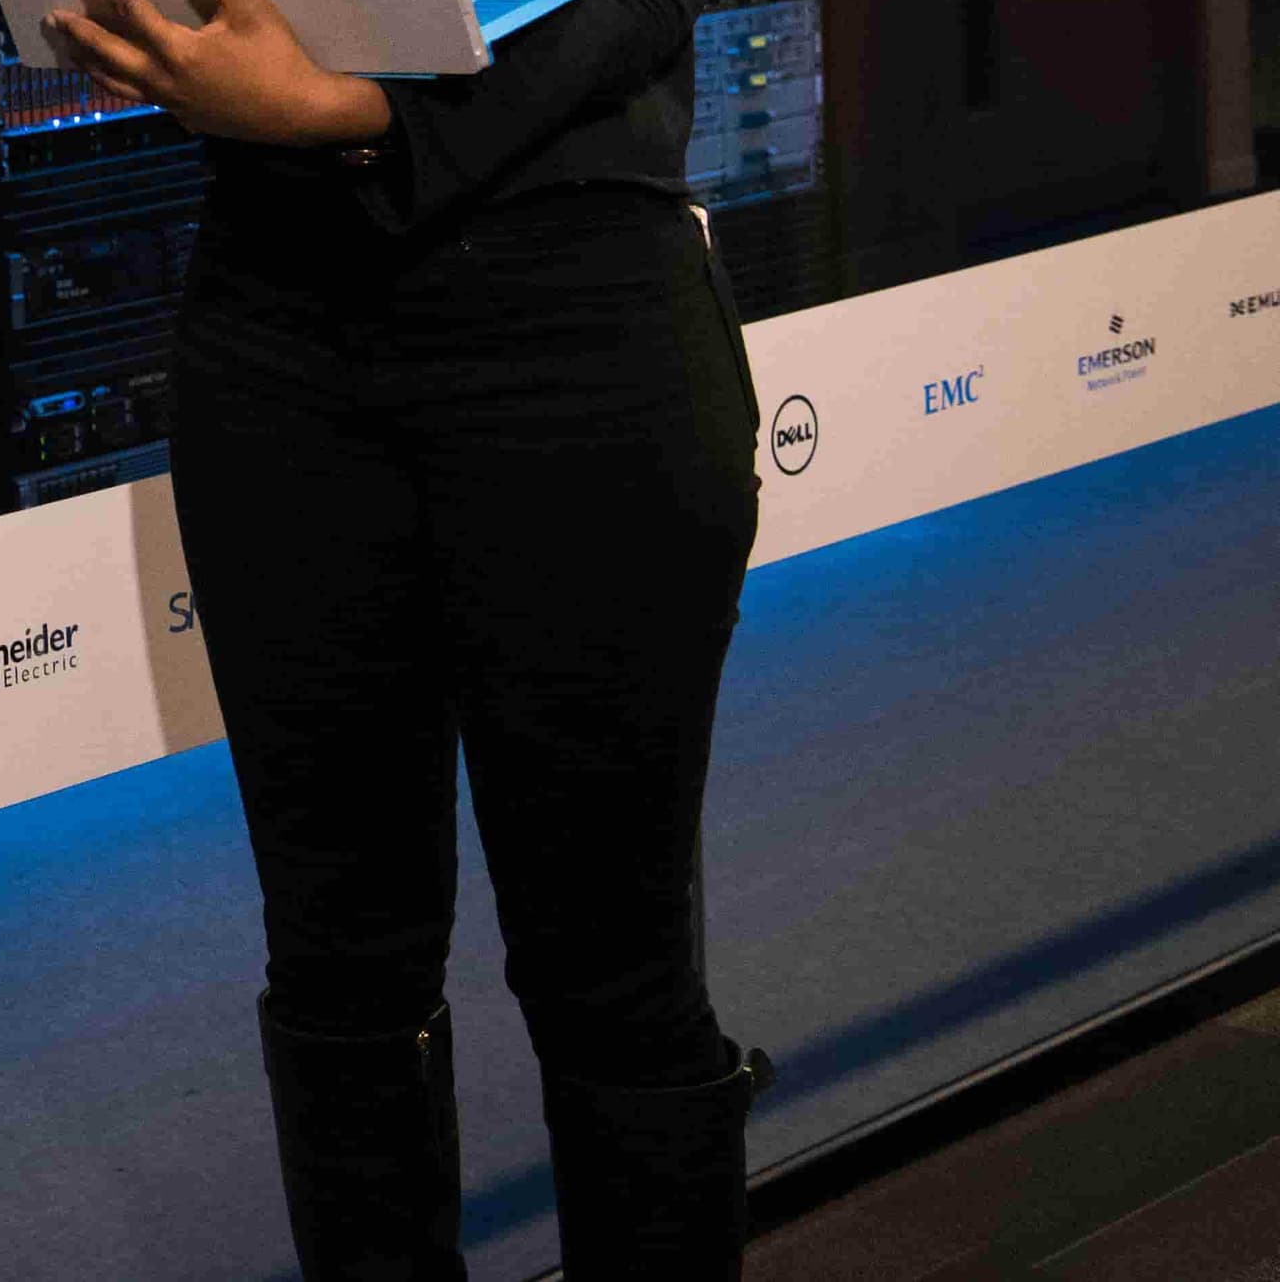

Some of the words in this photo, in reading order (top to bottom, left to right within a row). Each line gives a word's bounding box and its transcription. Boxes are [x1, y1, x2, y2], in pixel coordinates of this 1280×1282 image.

[1077, 337, 1155, 377] EMERSON
[777, 423, 813, 448] DELL
[3, 654, 78, 688] Electric
